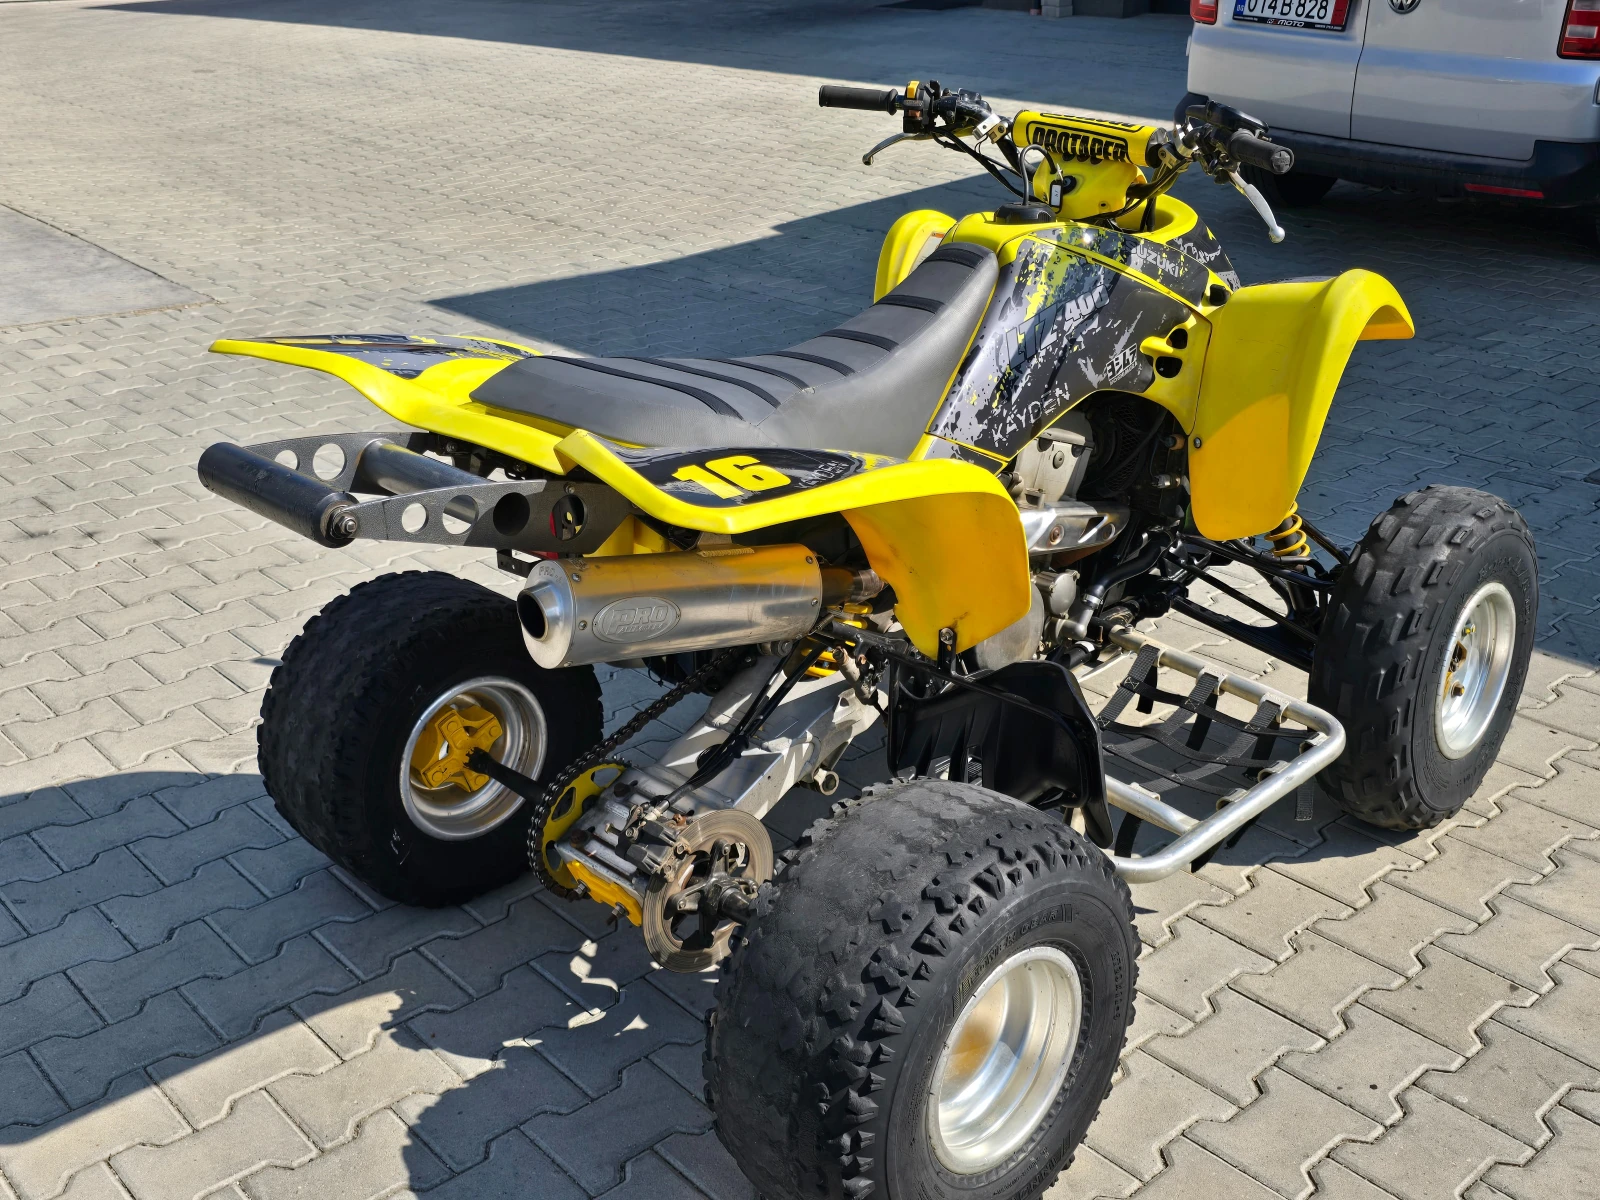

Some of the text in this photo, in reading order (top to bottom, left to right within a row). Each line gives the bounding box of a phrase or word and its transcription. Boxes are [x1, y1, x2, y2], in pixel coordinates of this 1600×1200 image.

[1128, 238, 1180, 278] SUZUKI
[1006, 284, 1110, 369] LTZ 400
[991, 380, 1071, 448] KAYDEN
[671, 455, 792, 500] 16
[606, 605, 669, 636] PRO
